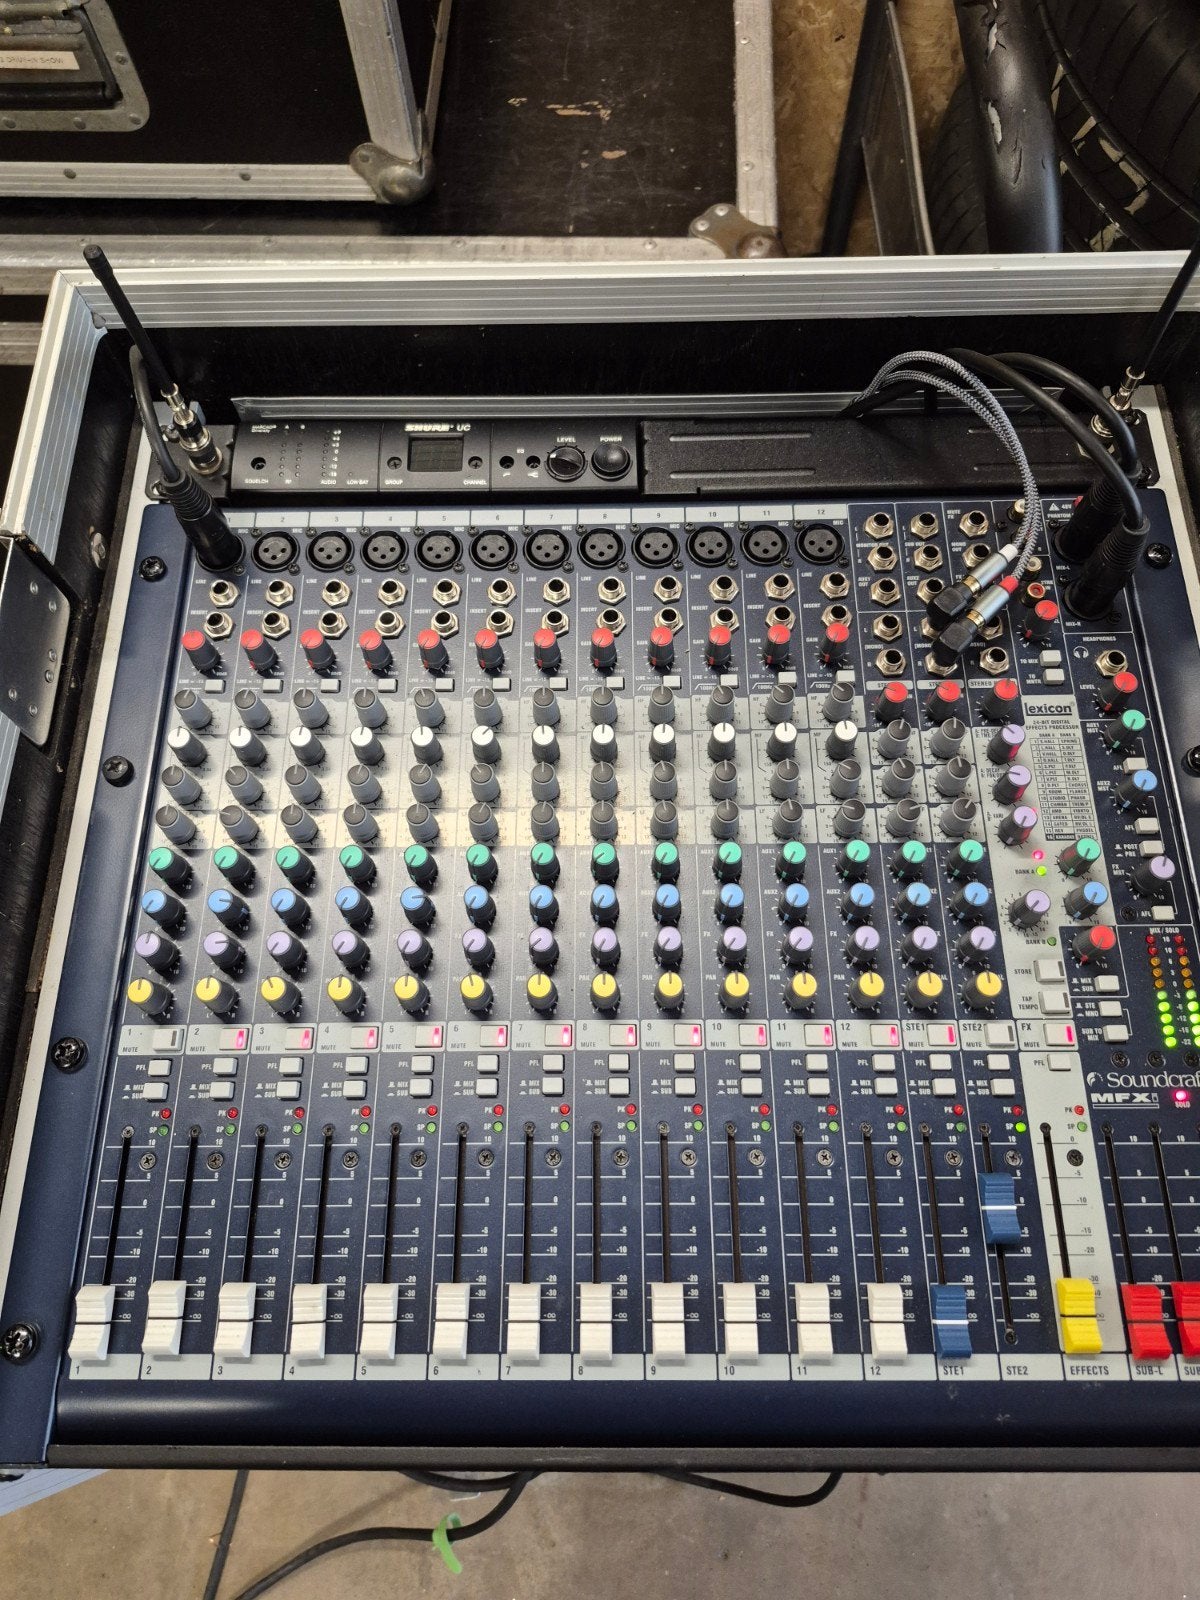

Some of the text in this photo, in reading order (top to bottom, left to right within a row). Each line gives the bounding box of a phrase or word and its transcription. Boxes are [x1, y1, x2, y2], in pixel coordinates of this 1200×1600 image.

[405, 424, 450, 432] SHURE
[906, 1023, 925, 1031] STE1
[75, 1366, 80, 1375] 1
[146, 1366, 151, 1375] 2
[217, 1366, 223, 1375] 3
[289, 1366, 294, 1375] 4
[361, 1366, 366, 1375] 5
[433, 1366, 438, 1375] 6
[506, 1366, 511, 1375] 7
[578, 1366, 583, 1375] 8
[651, 1366, 656, 1375] 9
[724, 1366, 734, 1375] 10
[797, 1366, 807, 1375] 11
[870, 1366, 881, 1375] 12
[943, 1365, 964, 1375] STE1
[1006, 1366, 1028, 1375] STE2
[1070, 1366, 1109, 1375] EFFECTS
[1136, 1366, 1163, 1375] SUB-L
